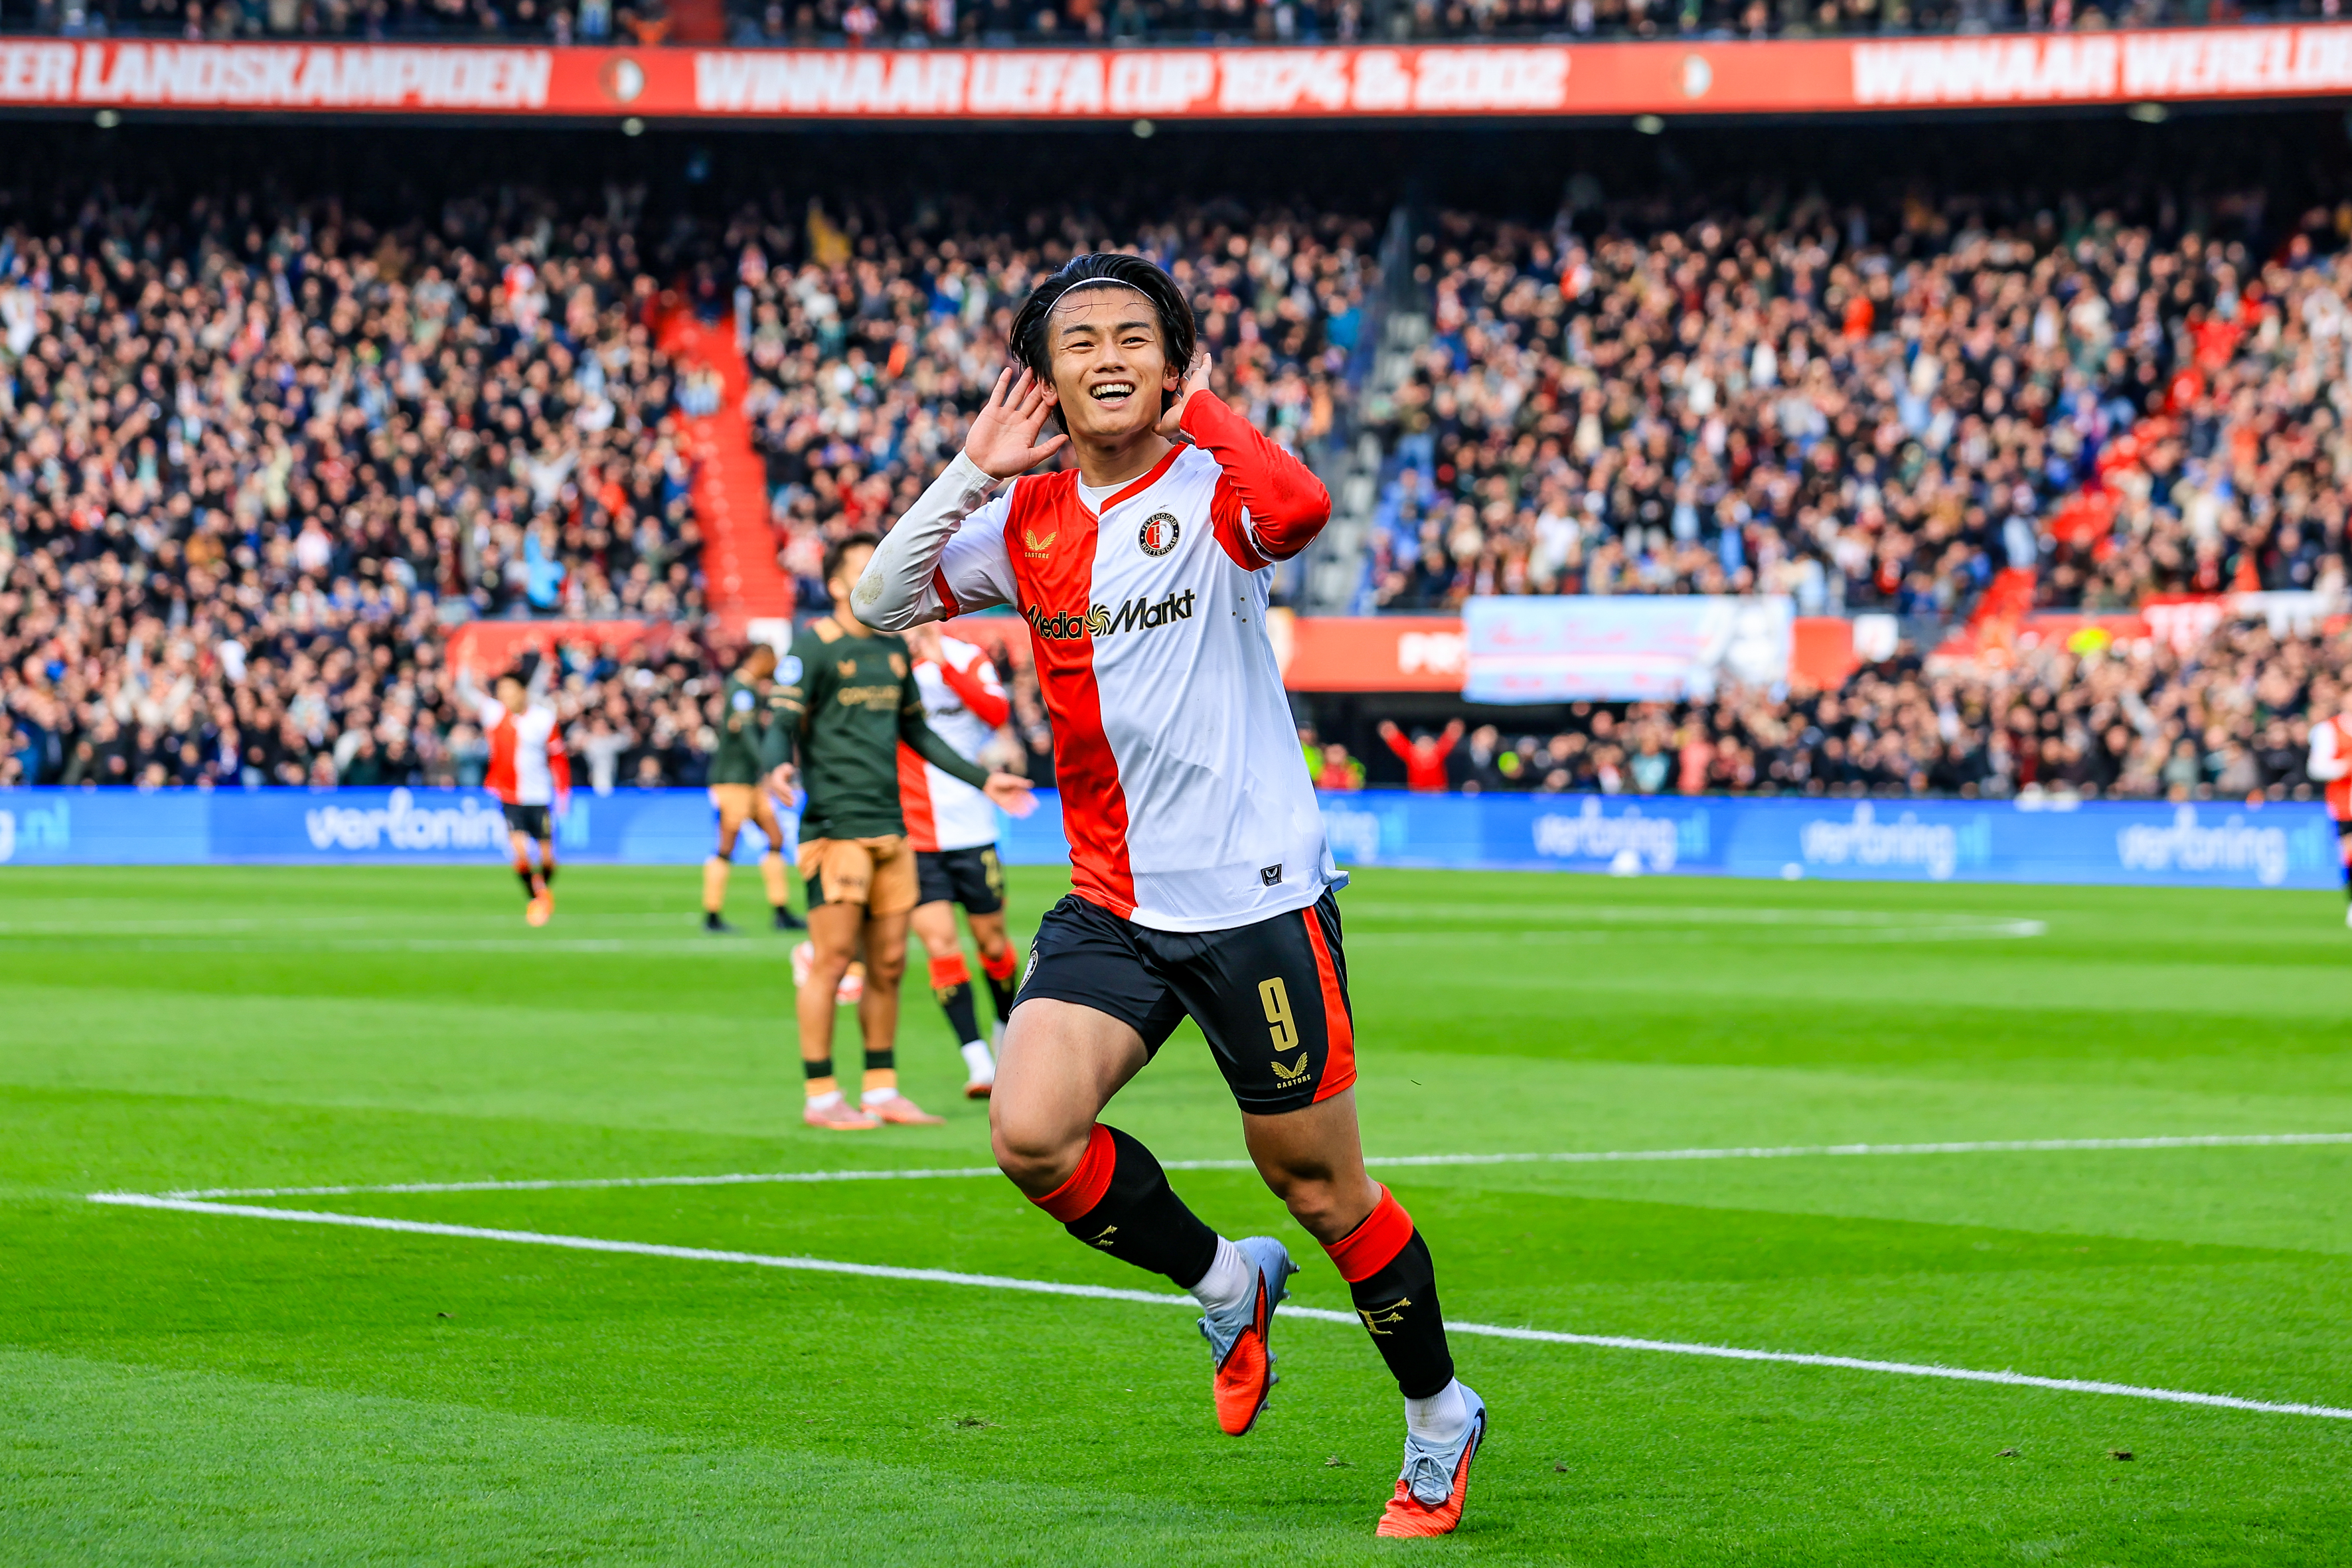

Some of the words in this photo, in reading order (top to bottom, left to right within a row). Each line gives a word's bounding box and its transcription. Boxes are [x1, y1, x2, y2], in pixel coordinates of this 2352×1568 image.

[77, 42, 552, 109] LANDSKAMPIOEN
[694, 51, 964, 112] WINNAAR
[969, 52, 1106, 113] UEFA
[1110, 52, 1215, 113] CUP
[1350, 49, 1413, 112] &
[1414, 48, 1569, 111] 2002
[1852, 34, 2118, 105] WINNAAR
[1141, 513, 1178, 532] FEYENOORD
[1141, 536, 1178, 556] ROTTERDAM
[1027, 603, 1085, 641] Media
[1107, 588, 1196, 636] Markt
[1258, 977, 1299, 1052] 9
[1277, 1073, 1312, 1089] CASTORE
